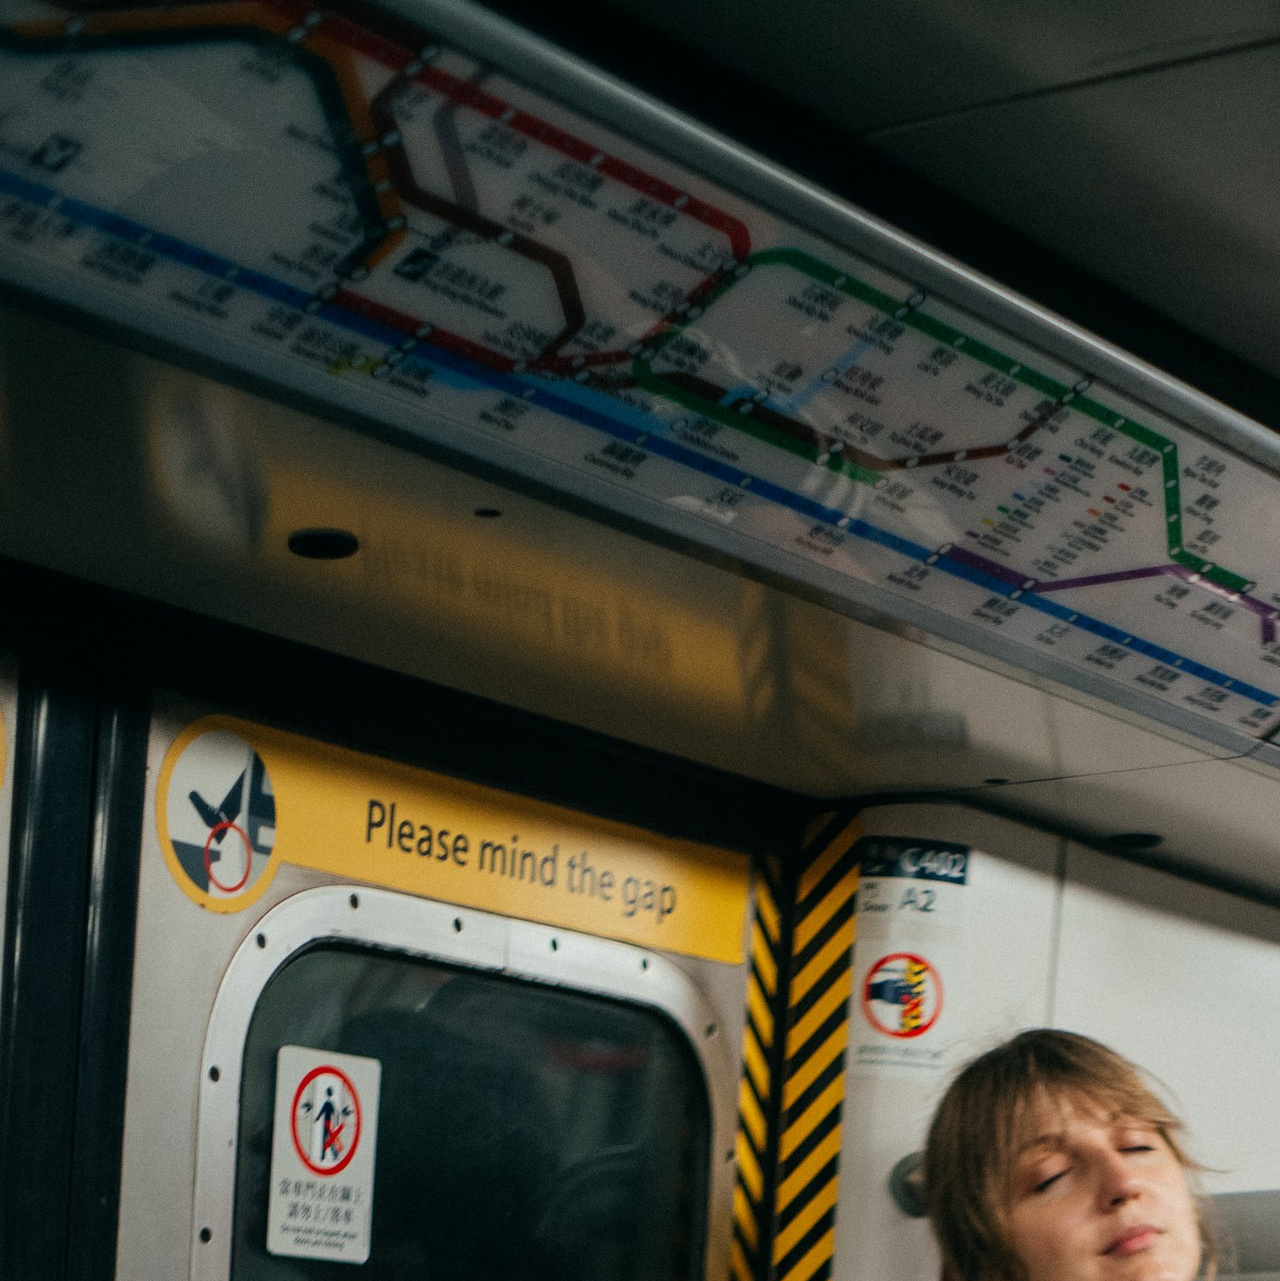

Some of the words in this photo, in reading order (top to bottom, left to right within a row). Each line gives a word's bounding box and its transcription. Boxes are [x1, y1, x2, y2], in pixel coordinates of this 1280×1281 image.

[364, 798, 470, 867] Please
[478, 834, 560, 887] mind
[567, 851, 616, 902] the
[622, 875, 676, 924] gap
[900, 845, 966, 878] C402
[897, 886, 937, 913] A2
